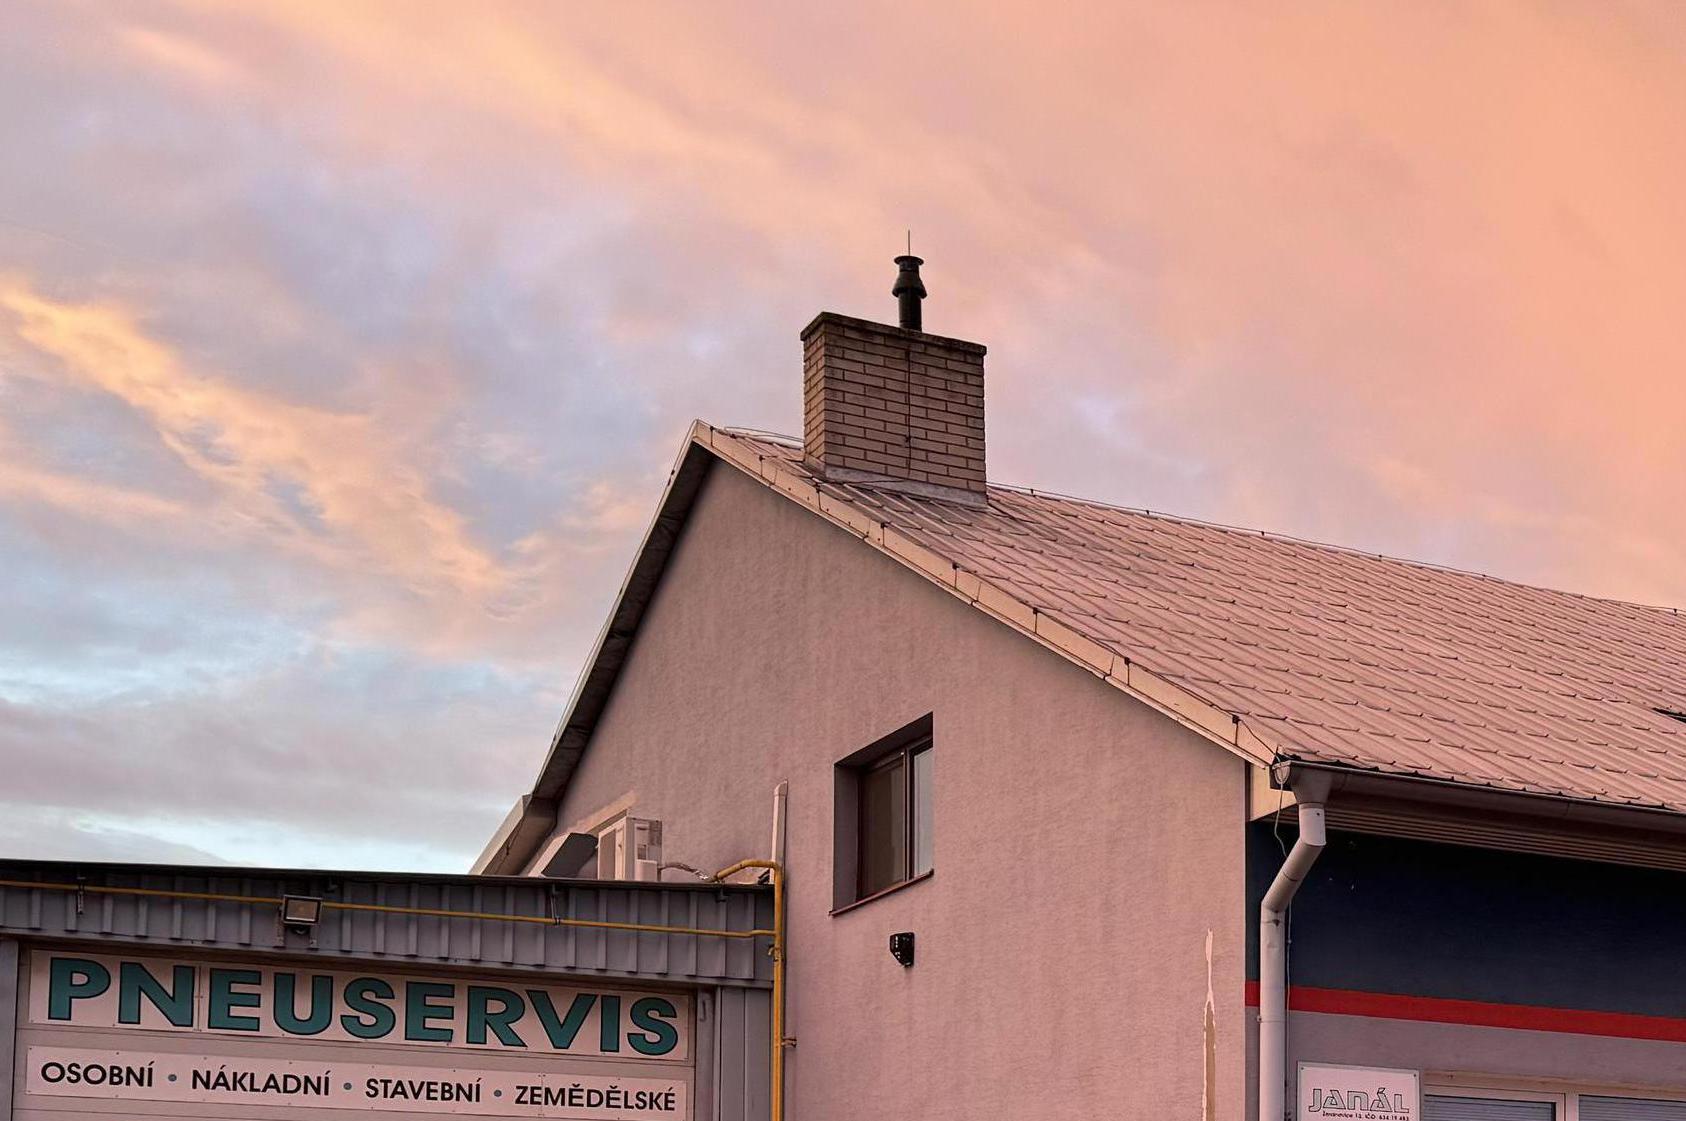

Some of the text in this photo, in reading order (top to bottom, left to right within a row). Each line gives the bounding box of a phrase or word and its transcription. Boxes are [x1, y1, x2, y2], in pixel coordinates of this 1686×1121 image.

[47, 956, 679, 1056] PNEUSERVIS
[40, 1060, 677, 1112] OSOBNÍ NÁKLADNÍ STAVEBNÍ ZEMĚDĚLSKÉ
